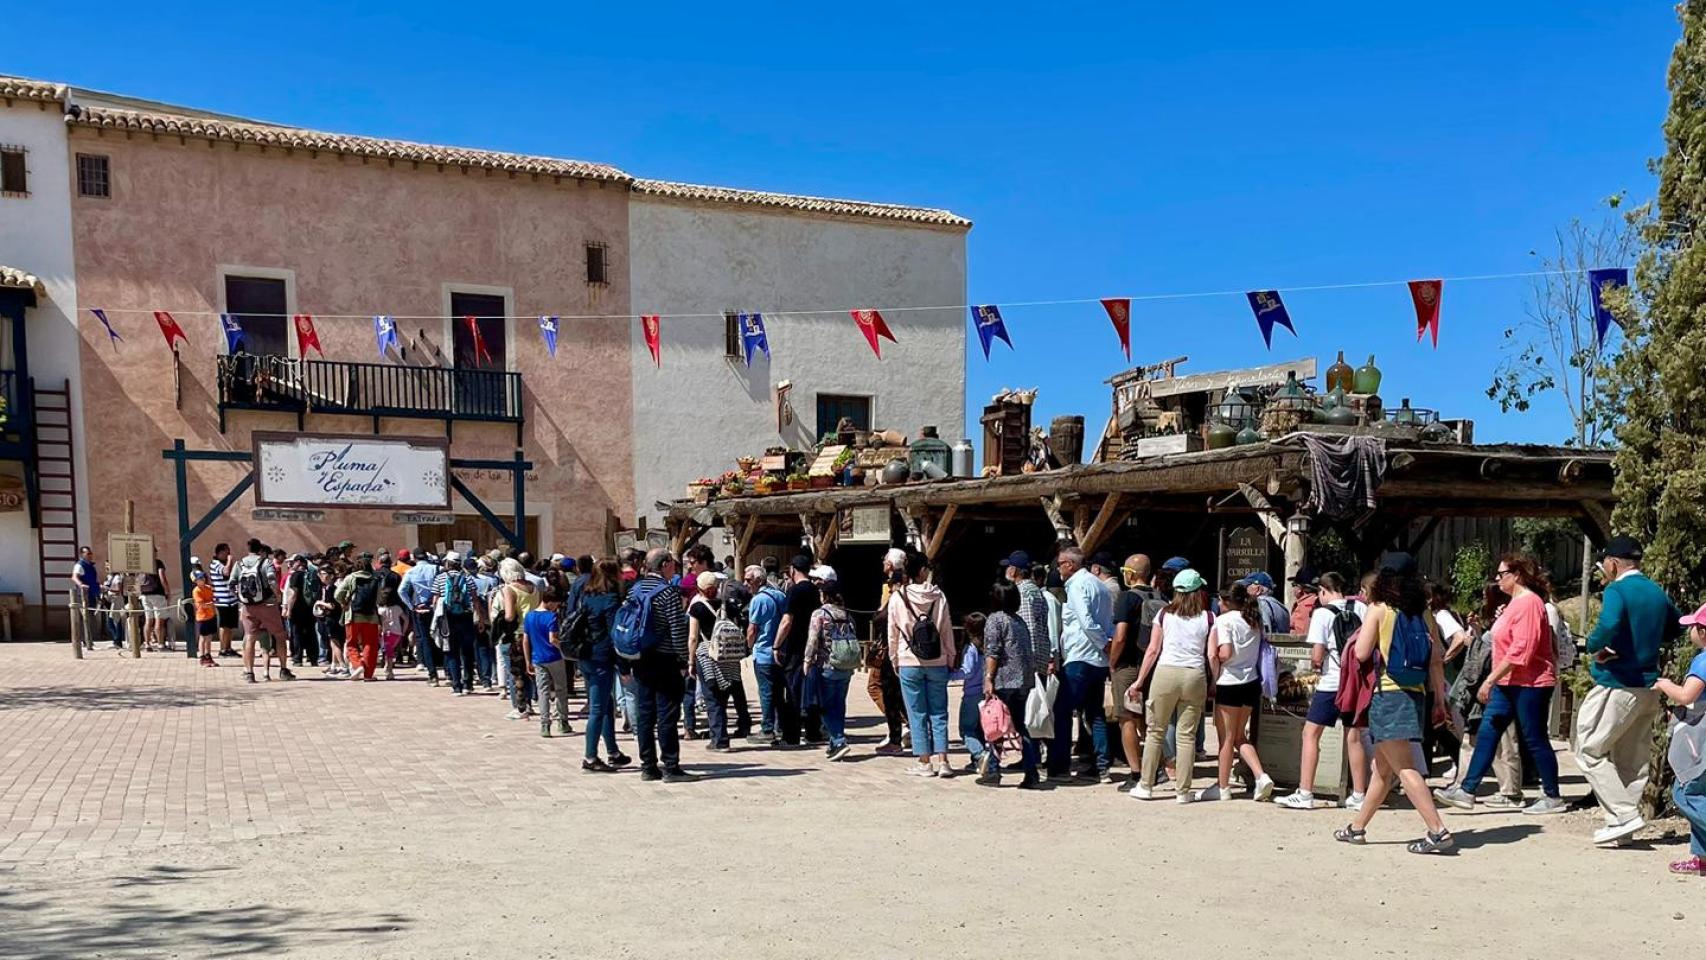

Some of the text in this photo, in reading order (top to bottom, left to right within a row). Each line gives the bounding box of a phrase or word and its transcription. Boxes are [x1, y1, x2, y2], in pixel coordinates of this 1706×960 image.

[314, 443, 379, 470] Pluma
[317, 459, 388, 499] y Espada
[1240, 537, 1252, 546] LA
